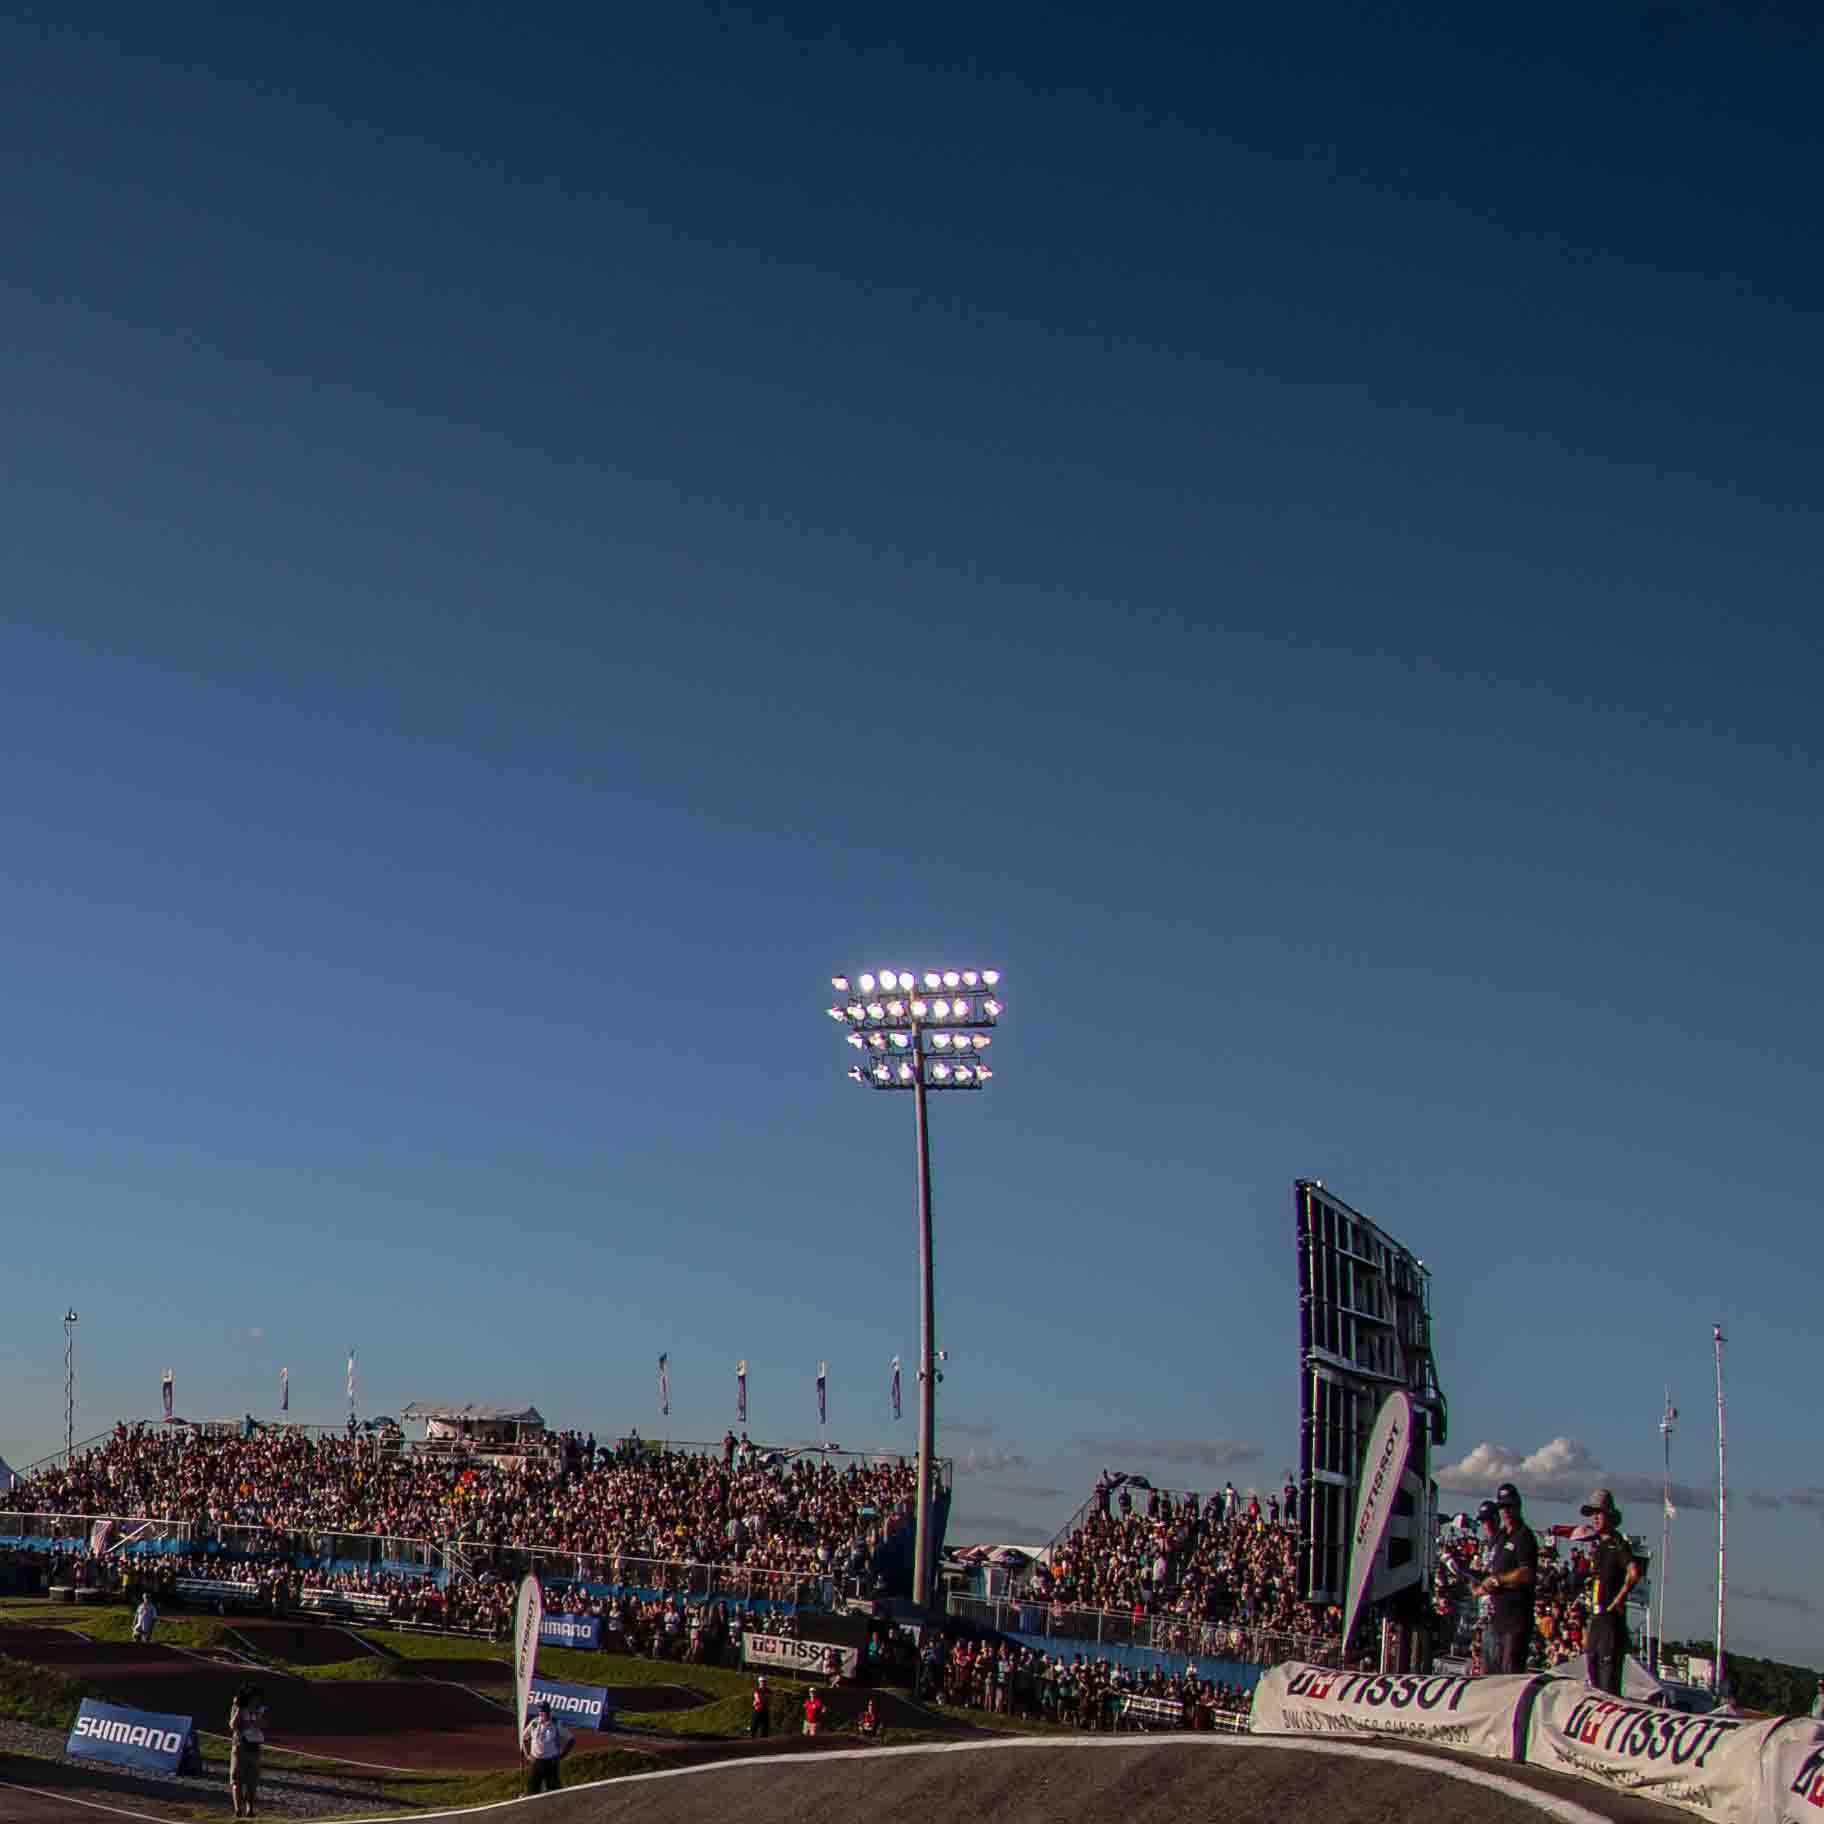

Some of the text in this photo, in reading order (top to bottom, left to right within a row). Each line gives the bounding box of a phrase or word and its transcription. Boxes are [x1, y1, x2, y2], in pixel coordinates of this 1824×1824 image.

[1365, 1419, 1400, 1515] TISSOT
[540, 1620, 592, 1638] IMANO
[1336, 1674, 1473, 1710] TISSOT
[74, 1716, 182, 1753] SHIMANO
[1605, 1706, 1741, 1768] TISSOT
